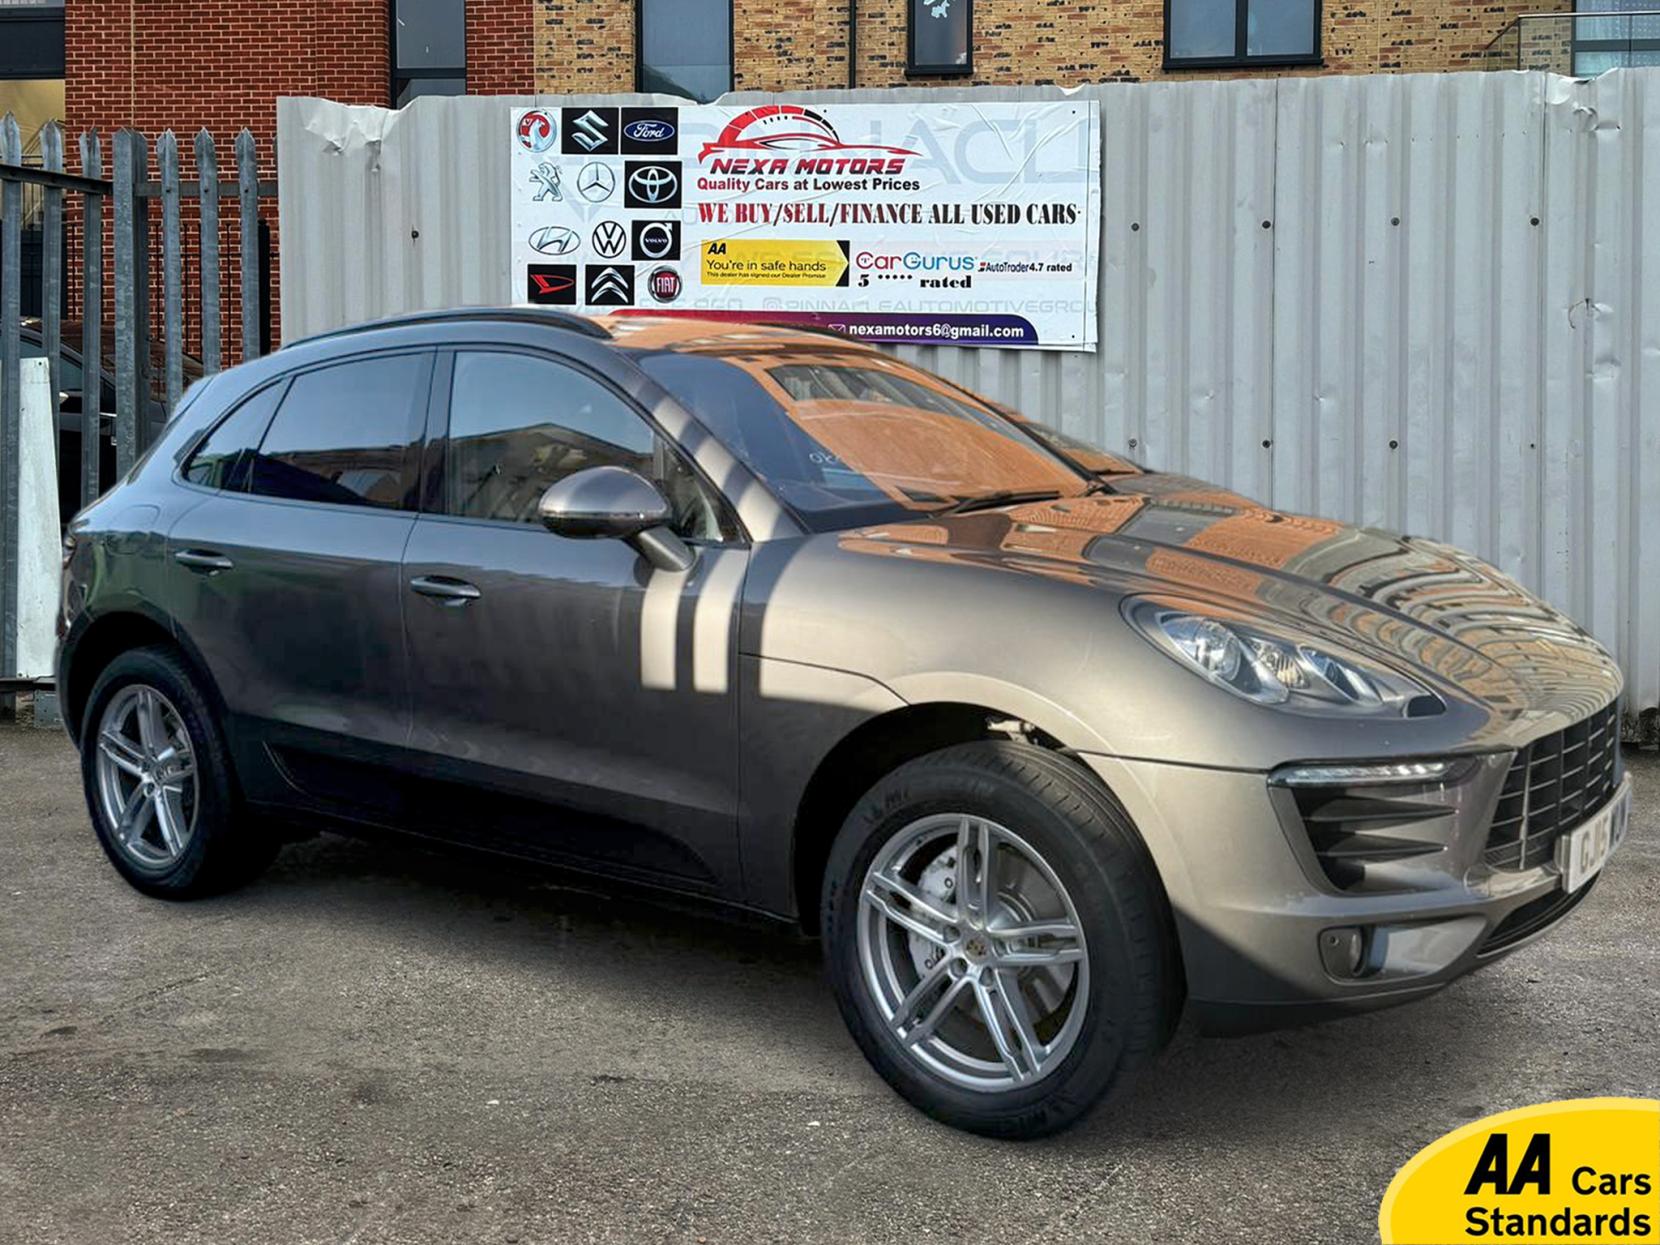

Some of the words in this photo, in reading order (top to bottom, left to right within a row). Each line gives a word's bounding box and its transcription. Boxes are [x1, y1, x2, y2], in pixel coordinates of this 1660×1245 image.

[633, 123, 664, 138] Ford
[710, 158, 789, 175] NEXA
[795, 158, 905, 175] MOTORS
[697, 177, 750, 193] Quality
[755, 177, 789, 190] Cars
[794, 179, 808, 190] at
[813, 177, 868, 190] Lowest
[873, 177, 920, 190] Prices
[698, 202, 728, 224] WE
[928, 203, 965, 225] ALL
[971, 203, 1021, 225] USED
[1027, 203, 1077, 225] CARS
[707, 242, 727, 255] AA
[706, 259, 744, 270] You're
[747, 260, 758, 270] in
[761, 260, 786, 271] safe
[789, 261, 827, 272] hands
[855, 251, 975, 271] CarGurus
[1046, 263, 1072, 272] rated
[656, 277, 676, 293] FIAT
[858, 274, 870, 288] 5
[920, 275, 972, 288] rated
[849, 323, 1024, 339] nexamotors6@gmail.com
